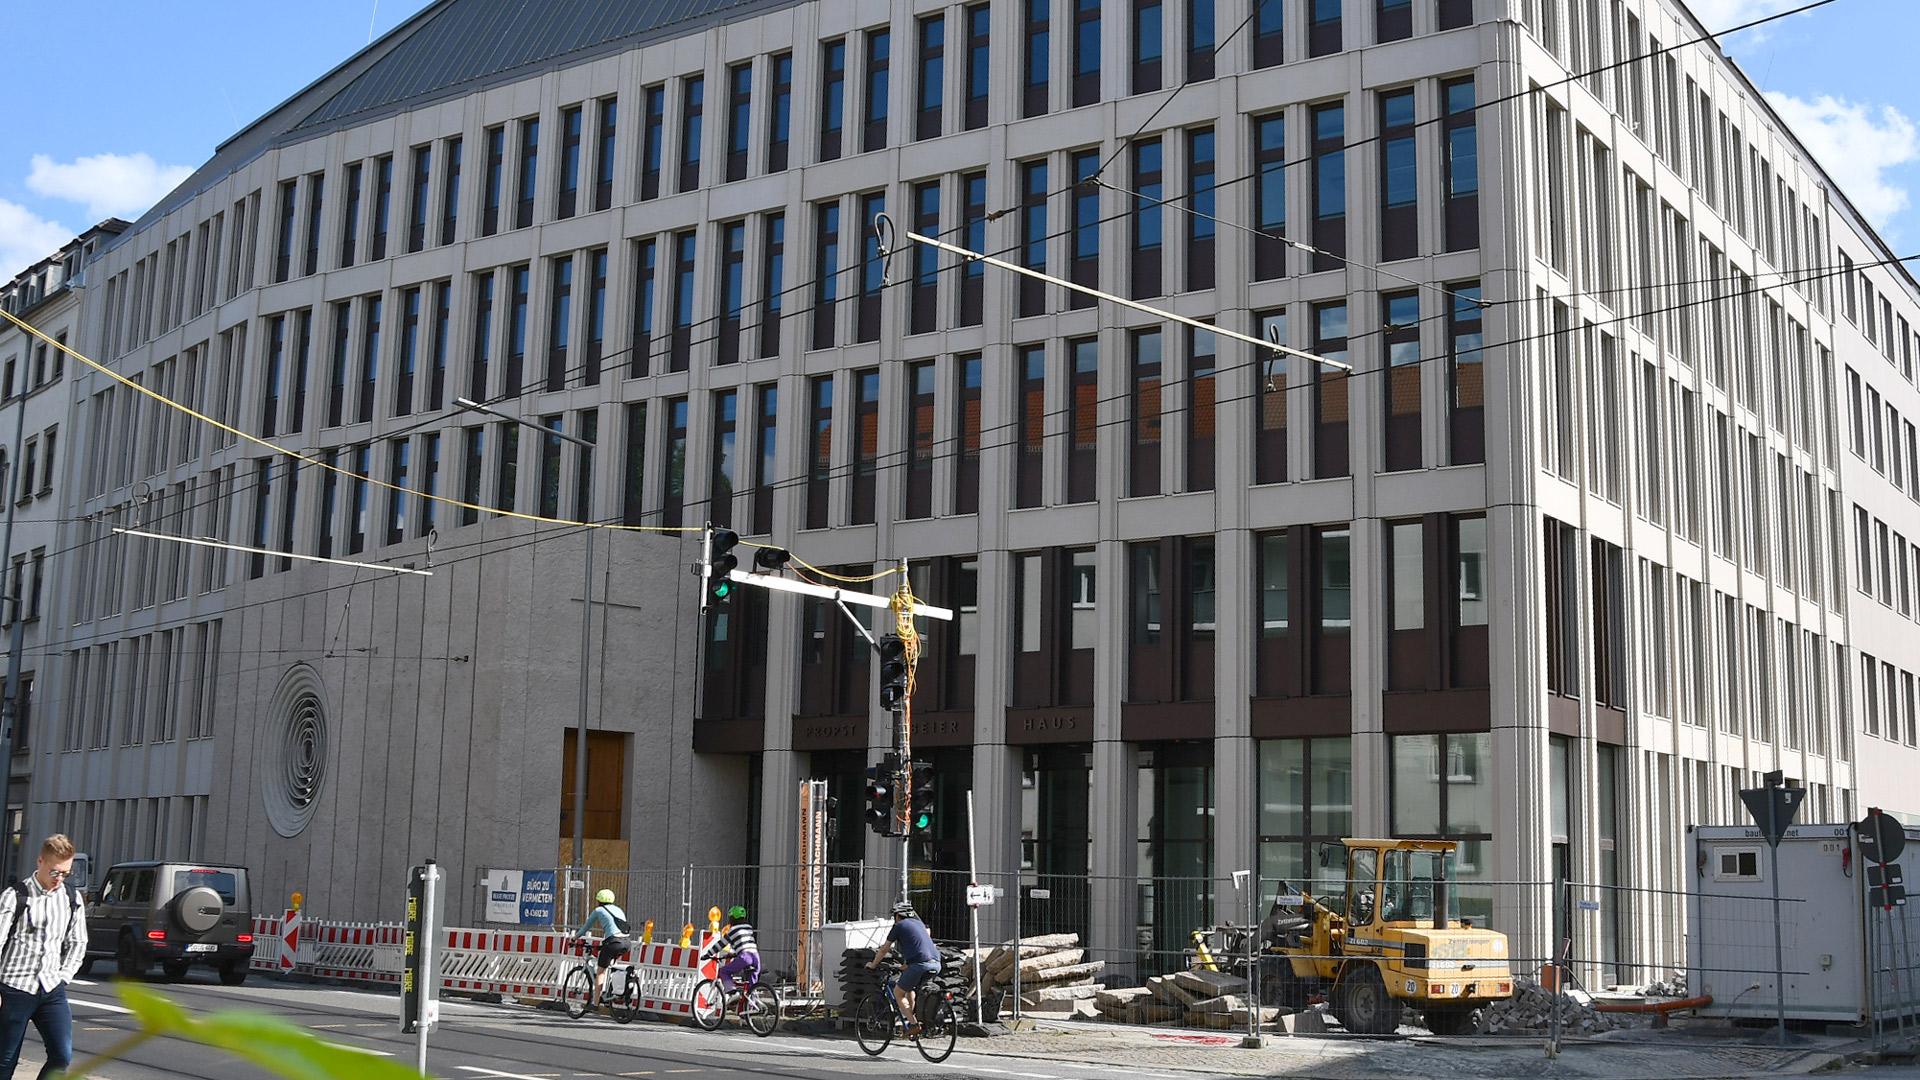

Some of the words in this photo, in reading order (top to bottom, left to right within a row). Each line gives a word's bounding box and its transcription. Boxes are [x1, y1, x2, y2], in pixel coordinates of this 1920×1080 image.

[806, 723, 857, 737] PROPST
[1023, 716, 1076, 731] HAUS
[813, 811, 822, 875] WACHMANN
[526, 878, 541, 891] BÜRO
[541, 880, 550, 891] ZU
[522, 892, 553, 904] VERMIETEN
[812, 876, 821, 930] DIGITALER
[1406, 981, 1415, 992] 20
[1451, 983, 1459, 994] 20
